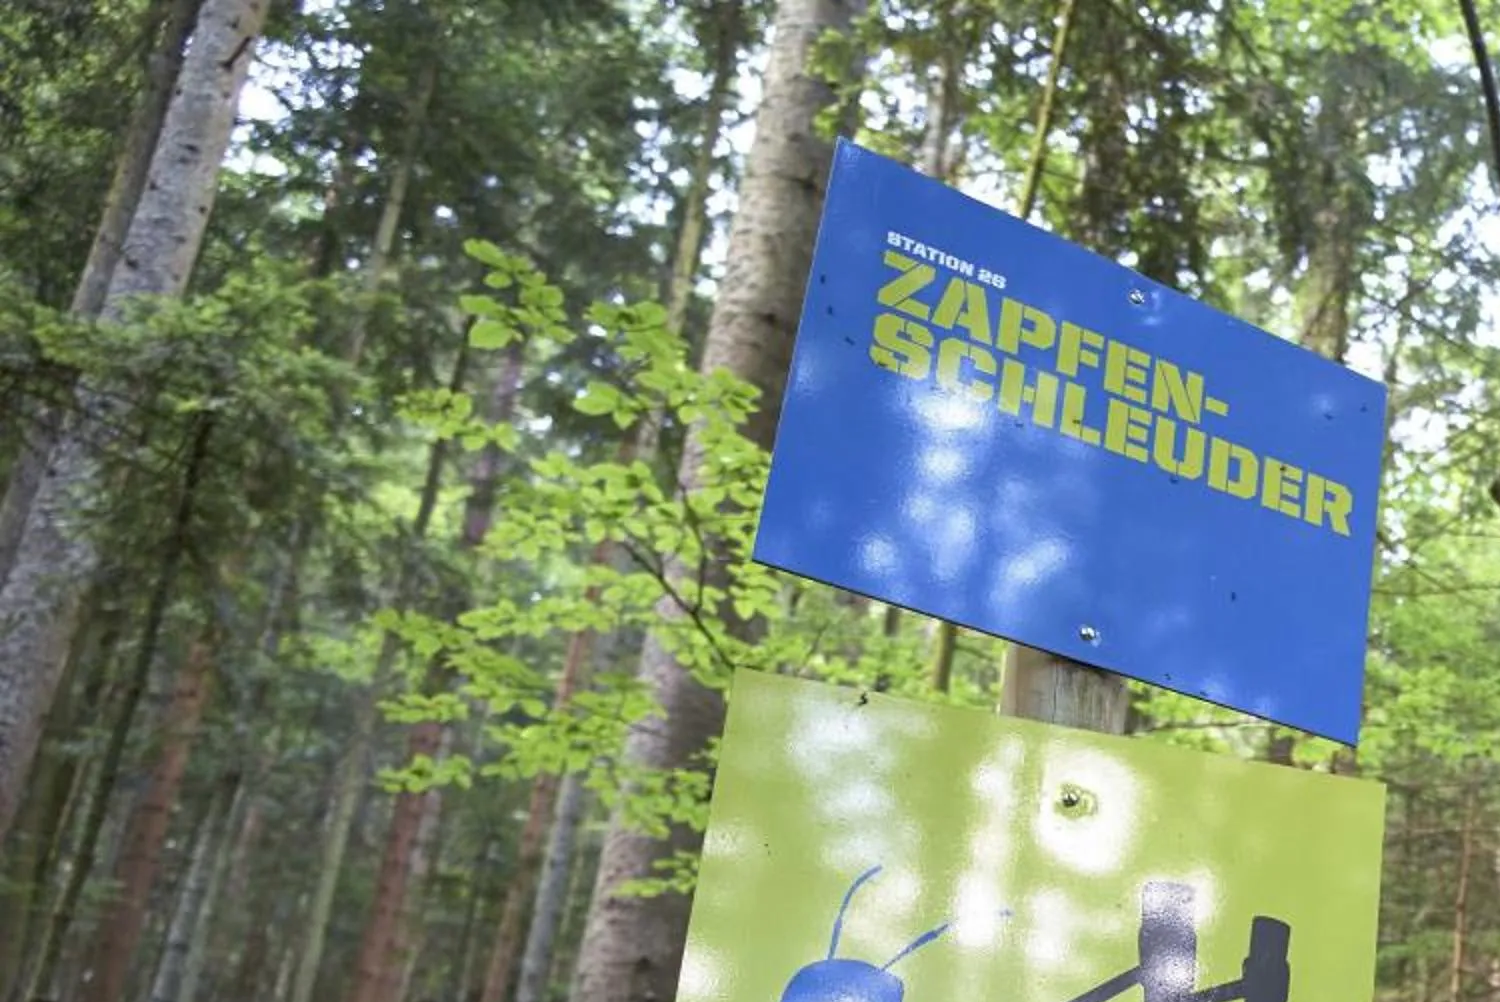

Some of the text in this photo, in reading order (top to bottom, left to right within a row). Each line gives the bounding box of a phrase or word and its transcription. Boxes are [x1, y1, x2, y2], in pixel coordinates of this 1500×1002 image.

[877, 249, 1229, 424] ZAPFEN-
[887, 231, 974, 277] STATION
[869, 313, 1353, 537] SCHLEUDER
